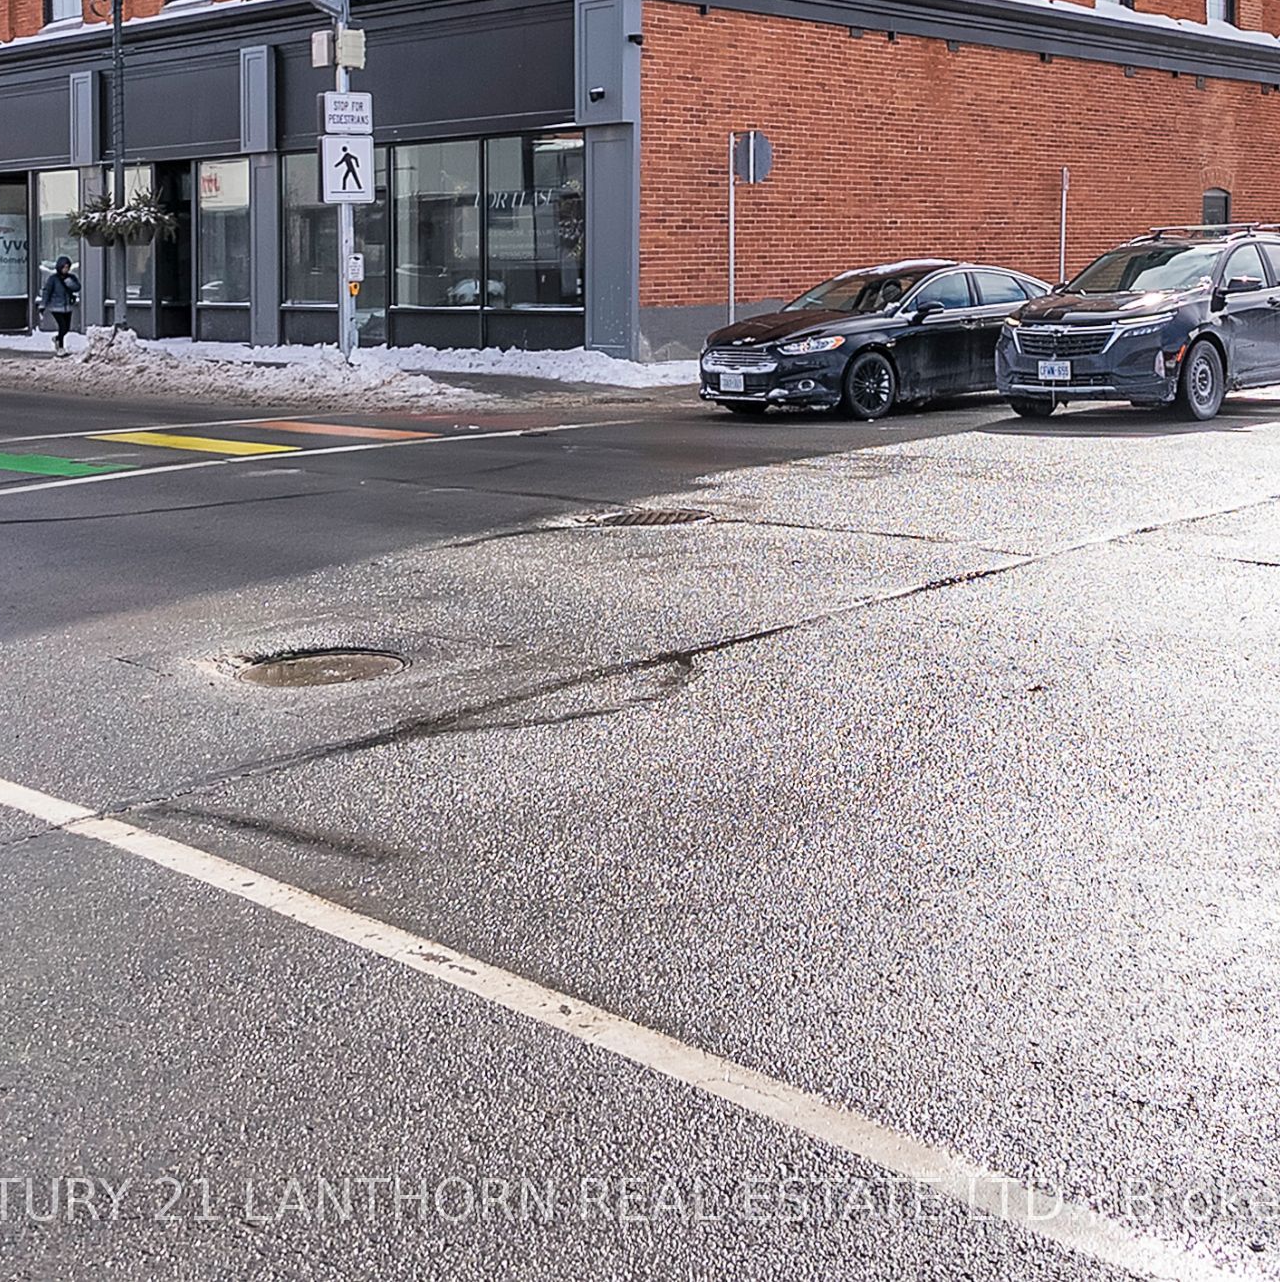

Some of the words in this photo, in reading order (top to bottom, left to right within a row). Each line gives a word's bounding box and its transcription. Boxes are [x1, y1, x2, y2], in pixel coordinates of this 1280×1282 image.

[333, 101, 349, 111] STOP
[352, 101, 364, 112] FOR
[329, 113, 369, 125] PEDESTRIANS
